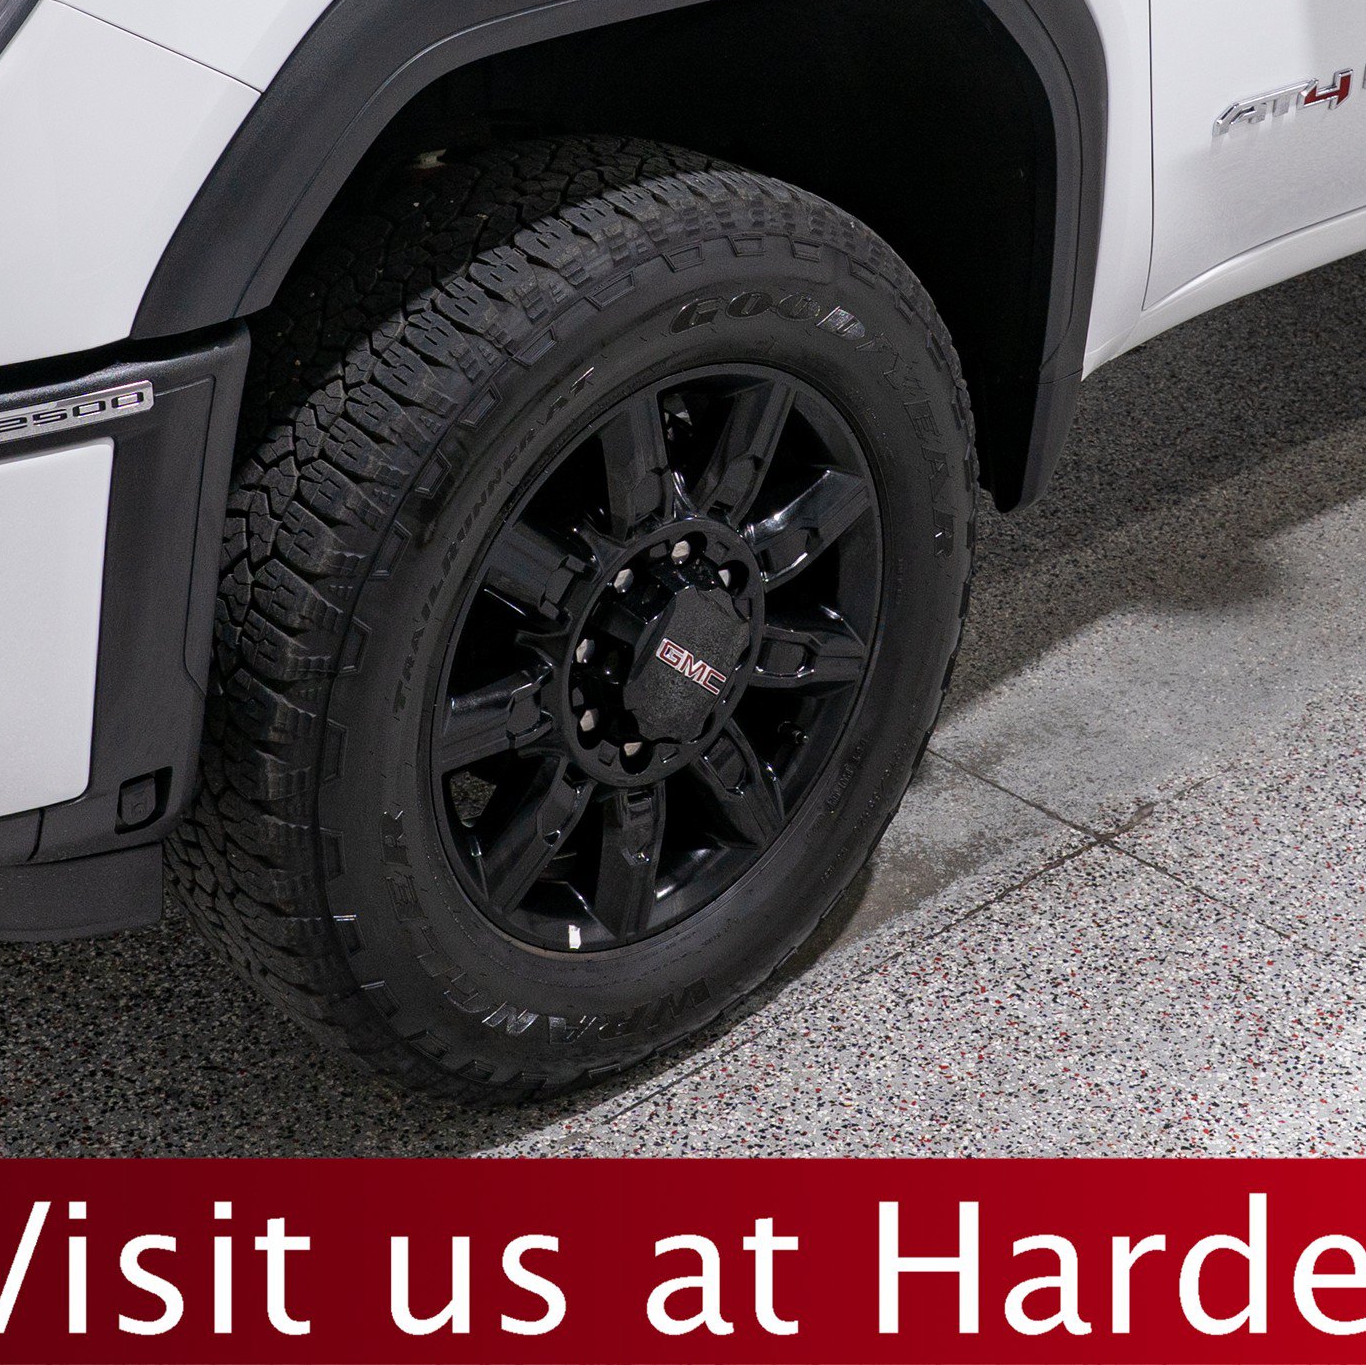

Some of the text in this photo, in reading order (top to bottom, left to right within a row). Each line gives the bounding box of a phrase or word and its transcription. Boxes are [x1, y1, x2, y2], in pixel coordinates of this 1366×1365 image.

[1212, 68, 1354, 136] AT4
[669, 291, 955, 557] GOODYEAR
[656, 637, 727, 696] GMC
